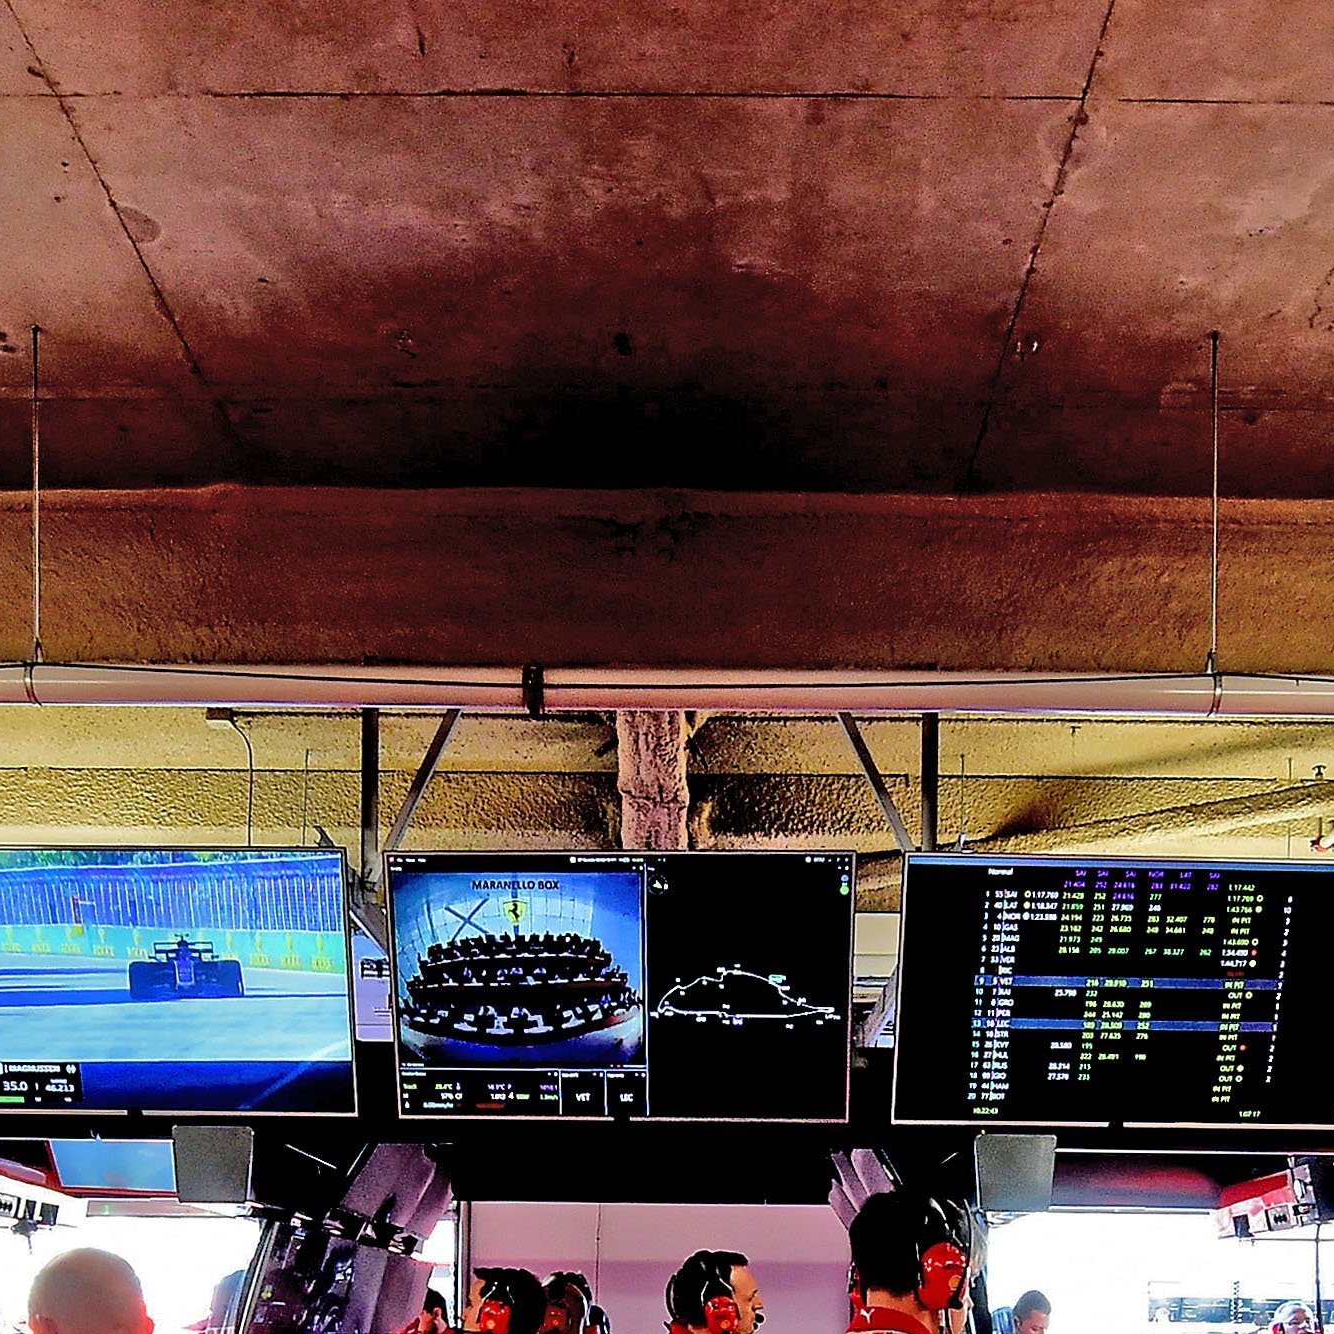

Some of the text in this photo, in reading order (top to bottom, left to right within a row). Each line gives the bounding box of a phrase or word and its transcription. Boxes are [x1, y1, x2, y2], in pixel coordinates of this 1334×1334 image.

[471, 879, 560, 891] MARANELLO BOX
[2, 1081, 28, 1091] 35.0
